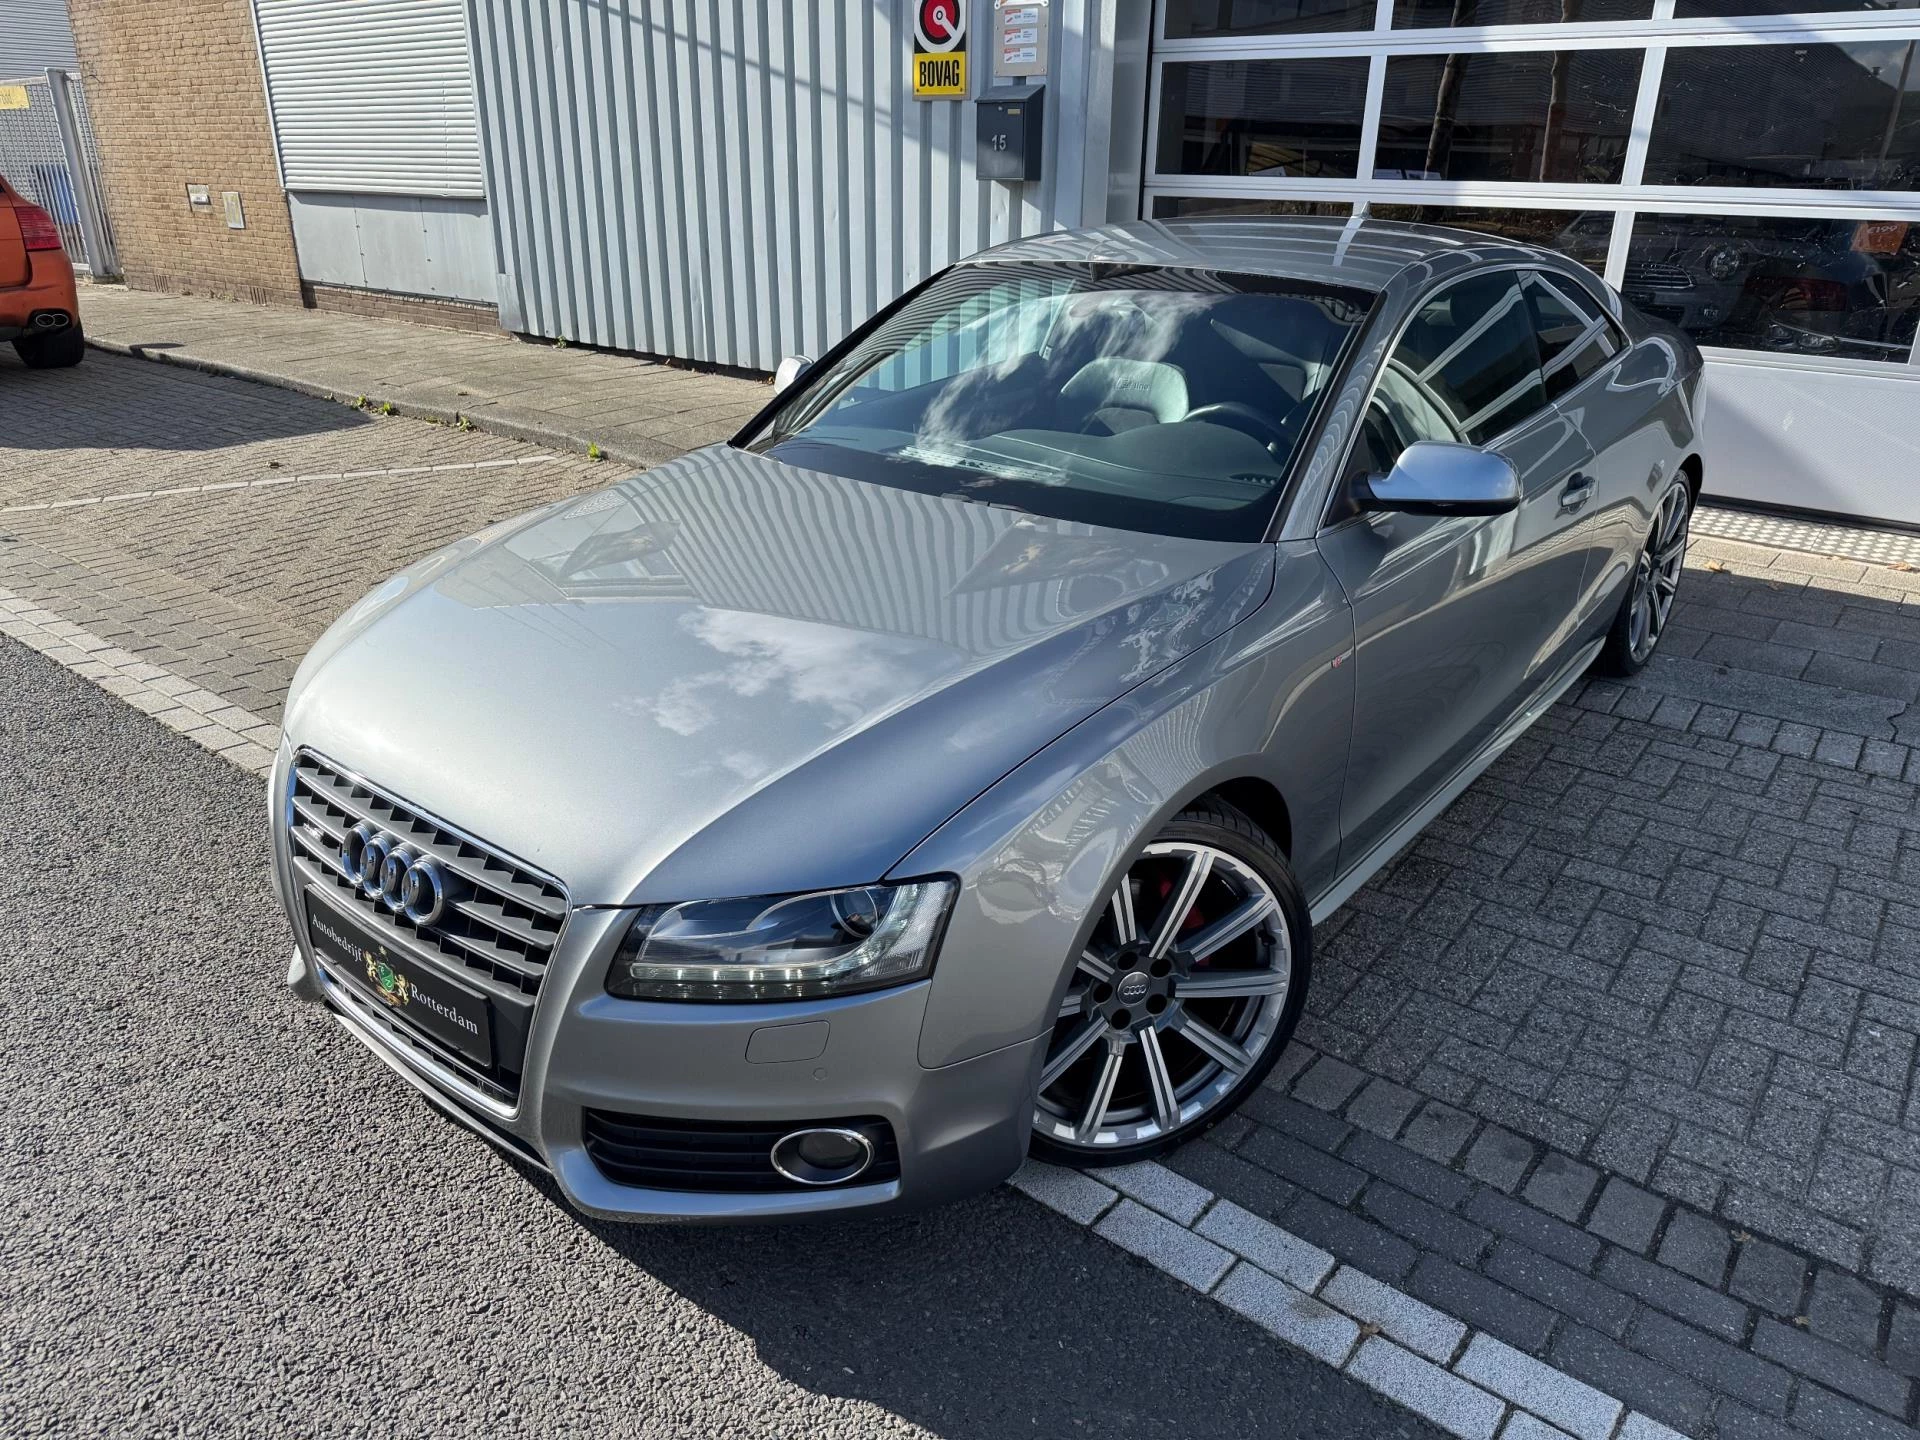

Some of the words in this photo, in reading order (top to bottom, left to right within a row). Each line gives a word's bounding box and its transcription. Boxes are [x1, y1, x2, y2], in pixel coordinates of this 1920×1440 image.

[919, 59, 960, 88] BOVAG
[991, 134, 1007, 151] 15
[312, 914, 363, 962] Autobedrijf
[410, 982, 479, 1036] Rotterdam
